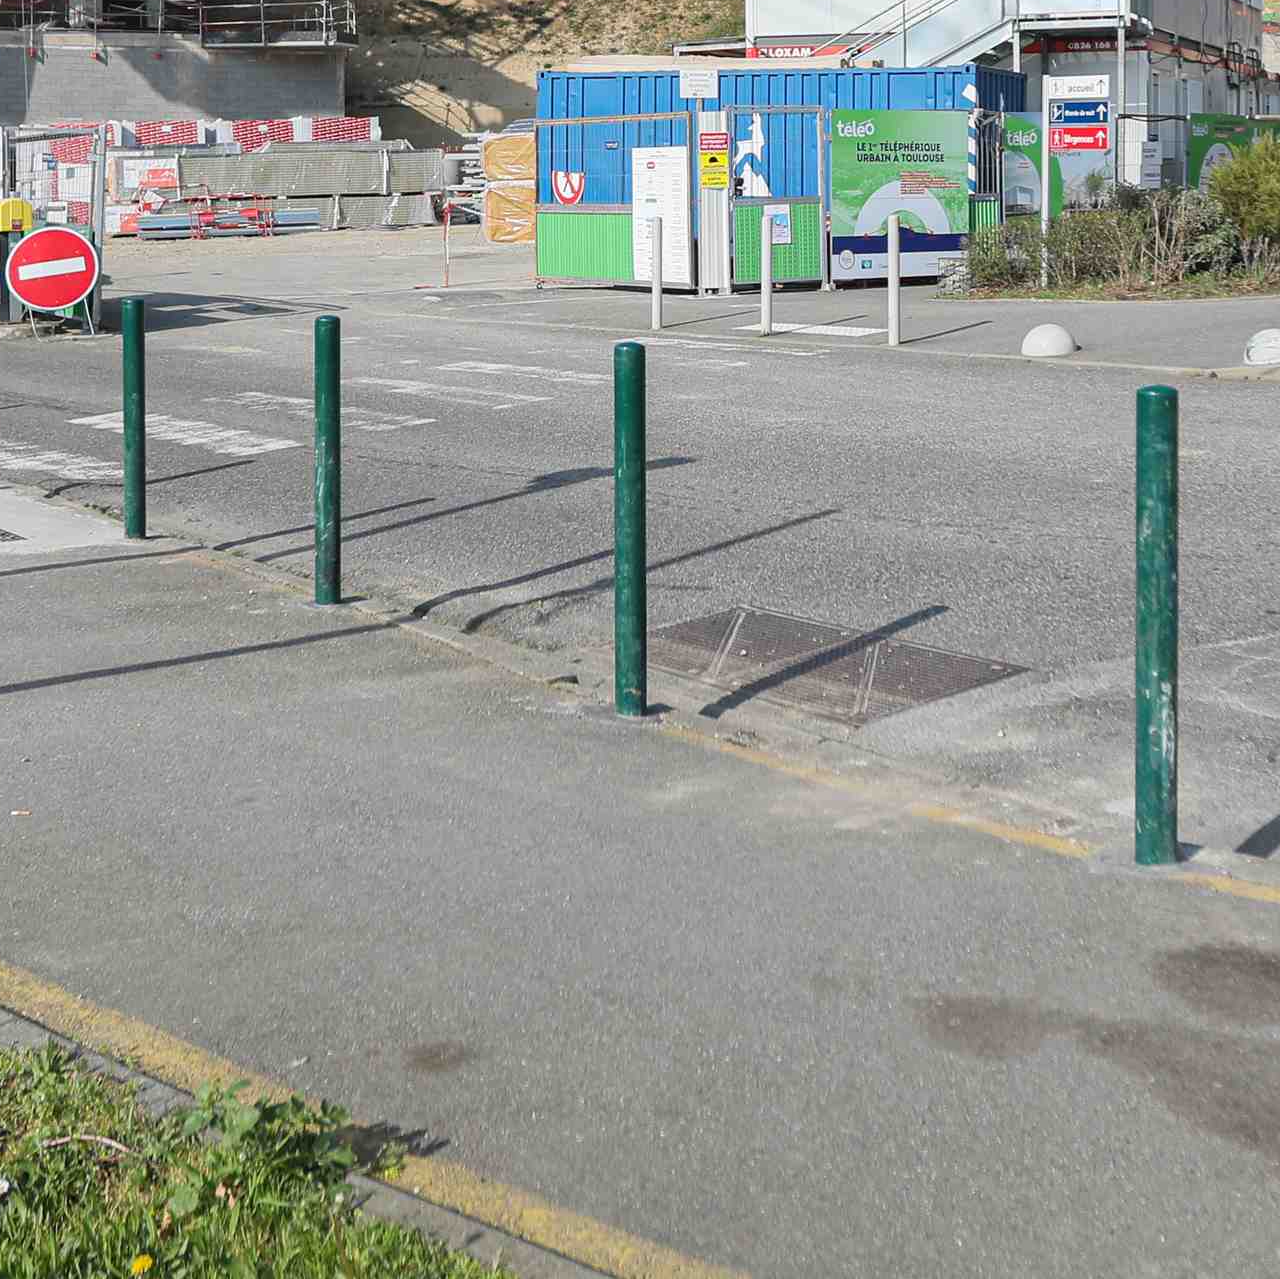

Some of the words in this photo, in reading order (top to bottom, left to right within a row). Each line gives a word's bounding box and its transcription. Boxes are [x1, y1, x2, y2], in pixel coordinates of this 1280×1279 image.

[768, 47, 812, 58] LOXAM
[856, 142, 867, 152] LE
[880, 140, 941, 152] TÉLÉPHÉRIQUE
[856, 153, 891, 163] URBAIN
[902, 153, 945, 163] TOULOUSE
